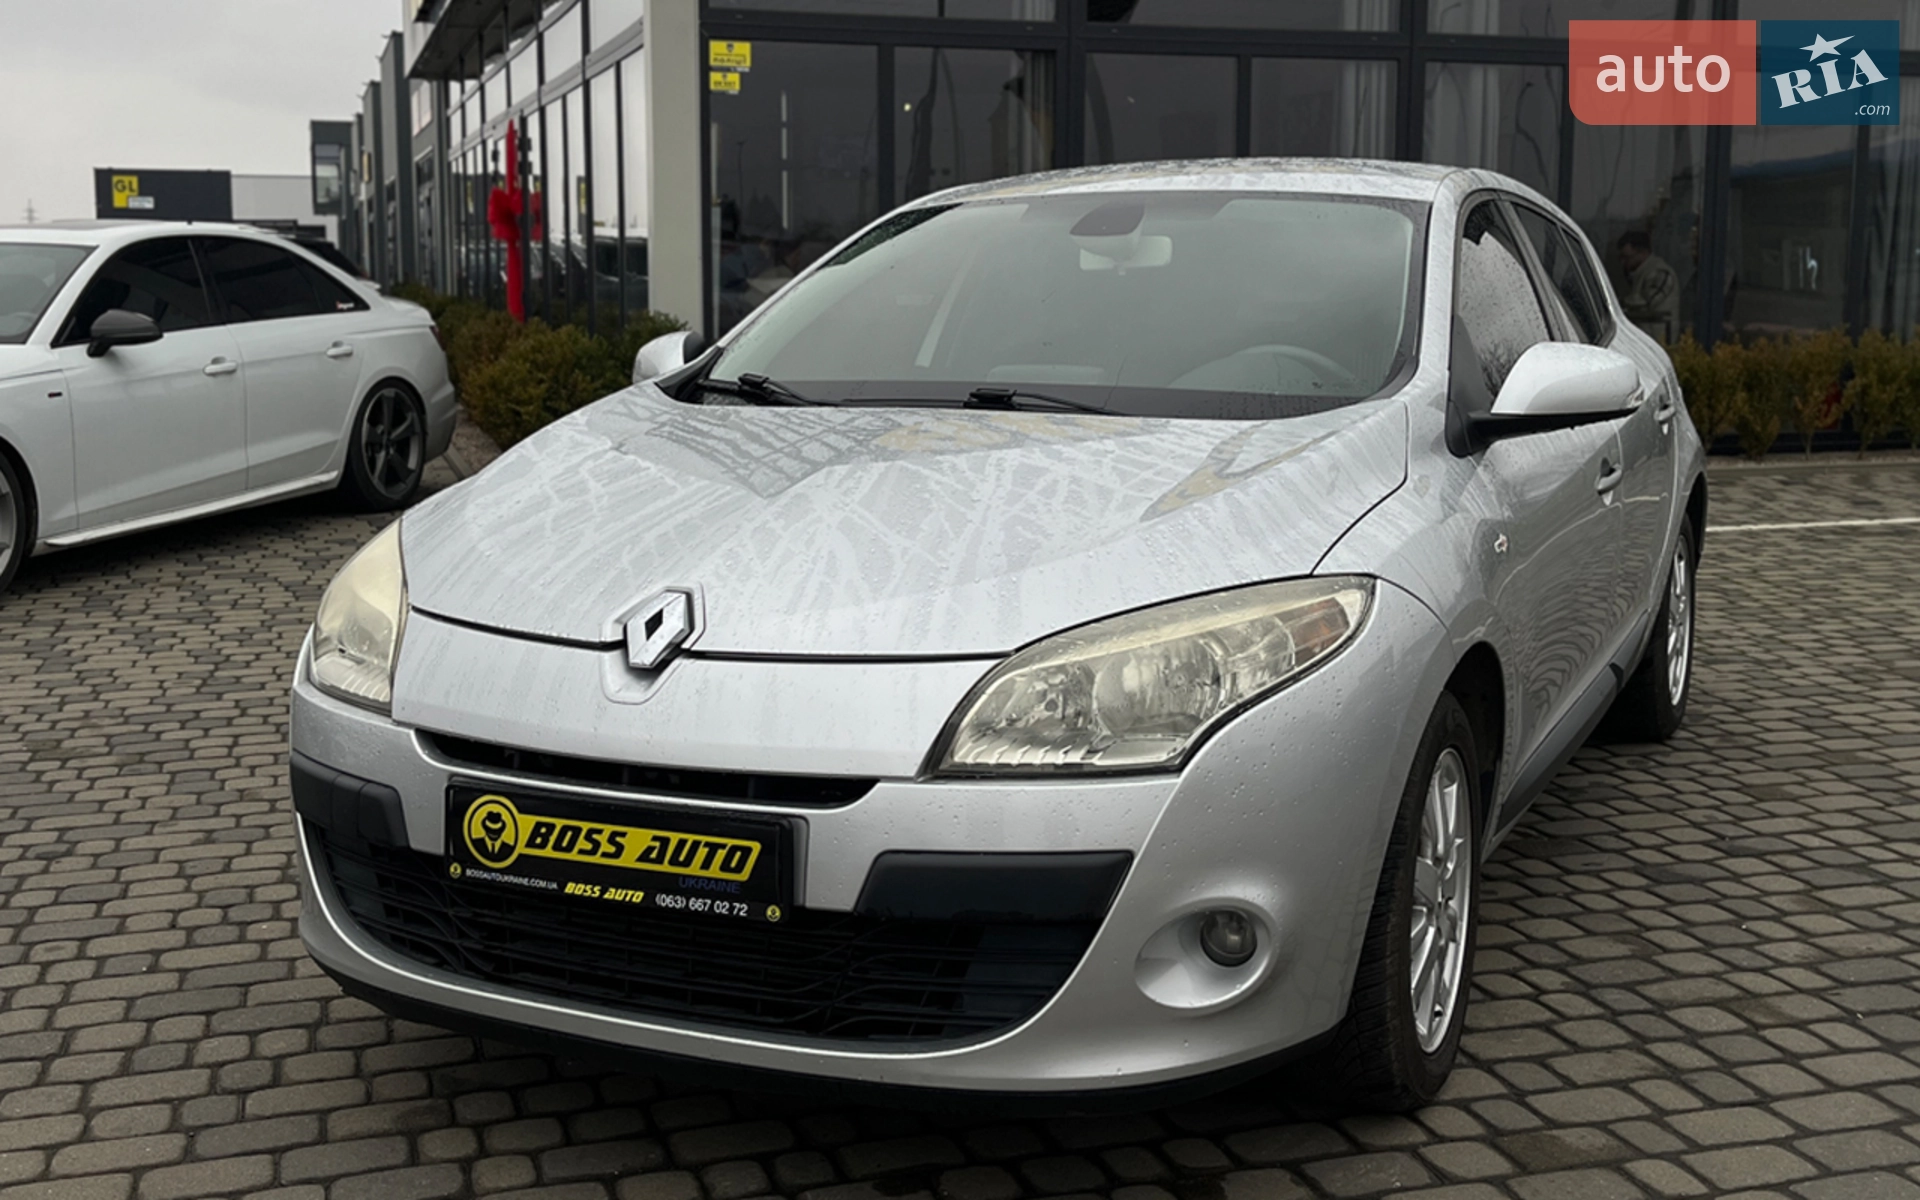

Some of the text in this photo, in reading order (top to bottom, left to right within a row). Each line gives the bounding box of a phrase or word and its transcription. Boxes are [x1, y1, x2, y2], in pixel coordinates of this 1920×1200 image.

[113, 179, 136, 193] GL
[524, 820, 754, 874] BOSS AUTO
[564, 881, 645, 904] BOSS AUTO
[679, 876, 741, 894] UKRAINE
[655, 893, 749, 917] (063) 667 02 72
